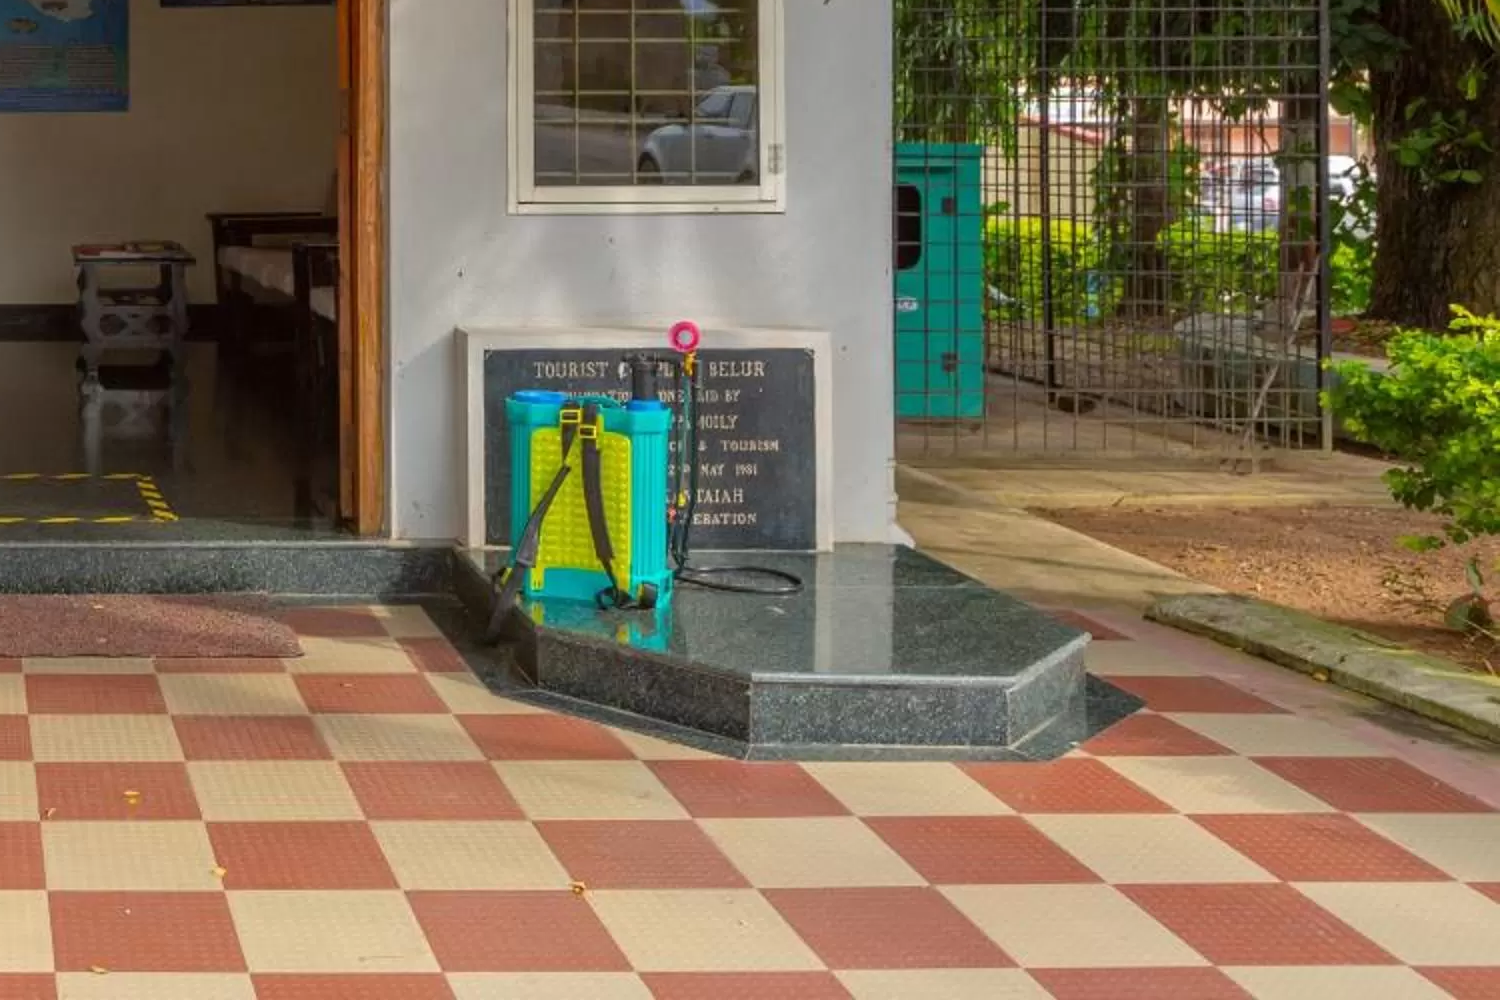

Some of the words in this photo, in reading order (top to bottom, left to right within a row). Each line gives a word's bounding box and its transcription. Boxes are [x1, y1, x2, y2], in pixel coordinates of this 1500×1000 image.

[533, 361, 609, 379] TOURIST
[709, 361, 766, 377] BELUR
[725, 390, 741, 402] BY
[721, 439, 779, 452] TOURISM
[701, 463, 725, 476] MAY
